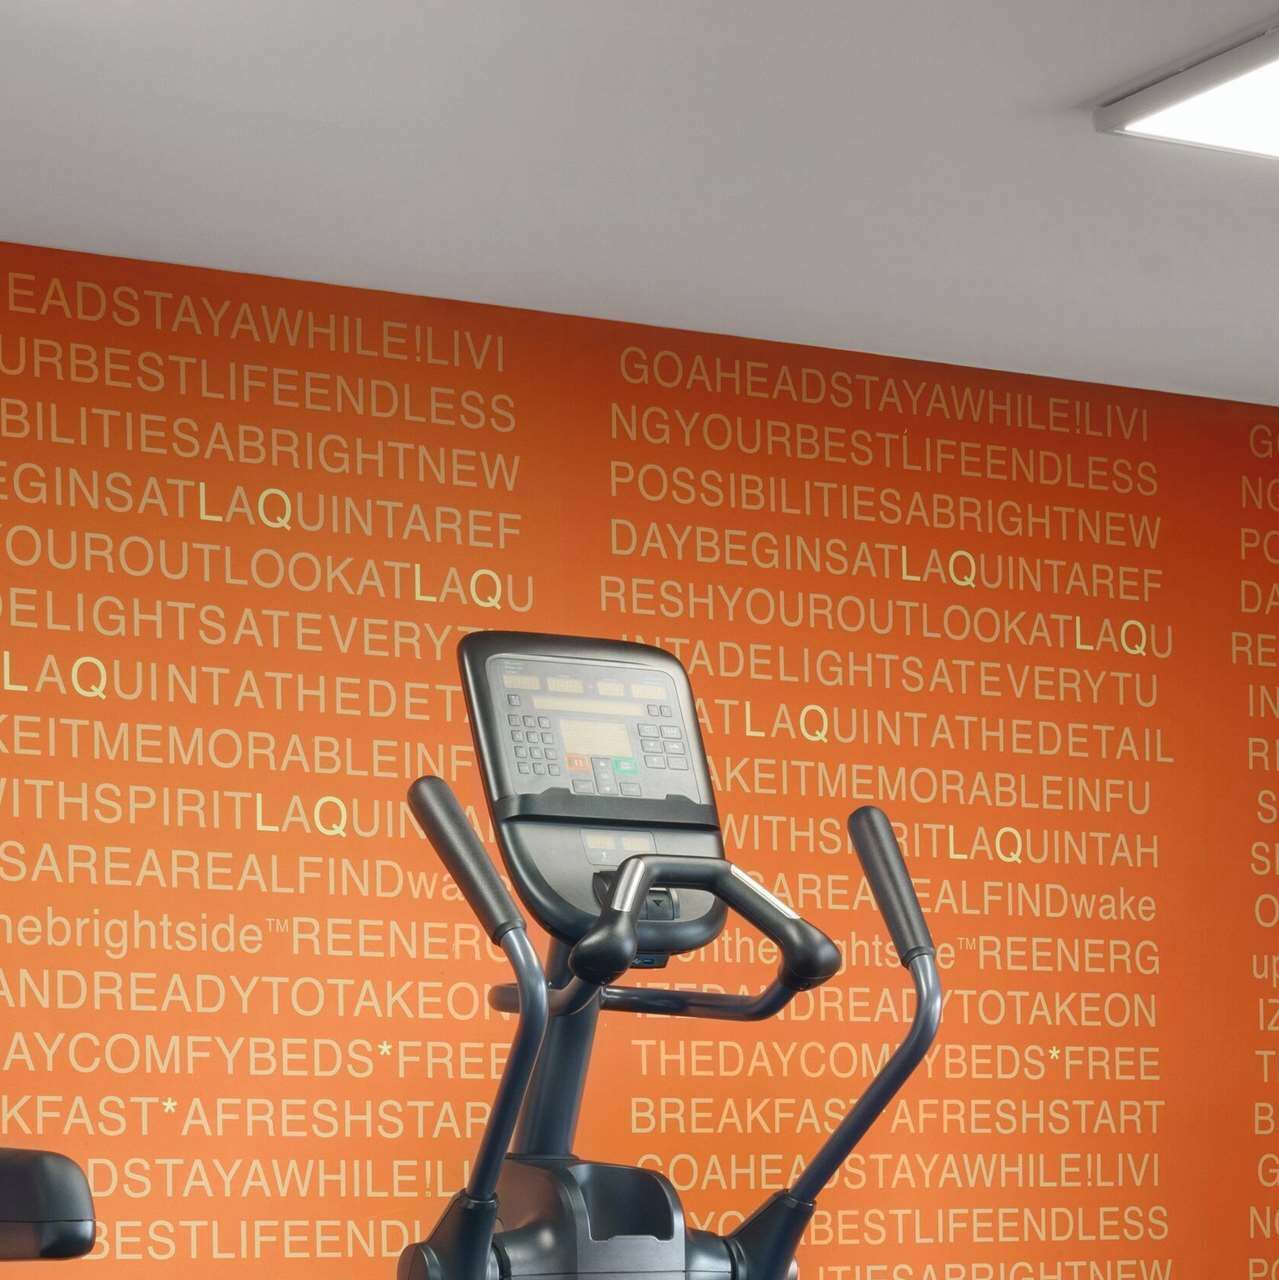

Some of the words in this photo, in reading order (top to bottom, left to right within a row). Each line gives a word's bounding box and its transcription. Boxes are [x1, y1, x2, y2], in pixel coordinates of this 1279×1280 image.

[620, 346, 1148, 442] GOAHEADSTAYAWHILE!LIVI
[610, 402, 1157, 497] NGYOURBESTLIFEENDLESS
[610, 460, 1161, 549] POSSIBILITIESABRIGHTNEW
[610, 518, 1163, 602] DAYBEGINSATLAQUINTAREF
[600, 575, 1173, 658] RESHYOUROUTLOOKATLAQU
